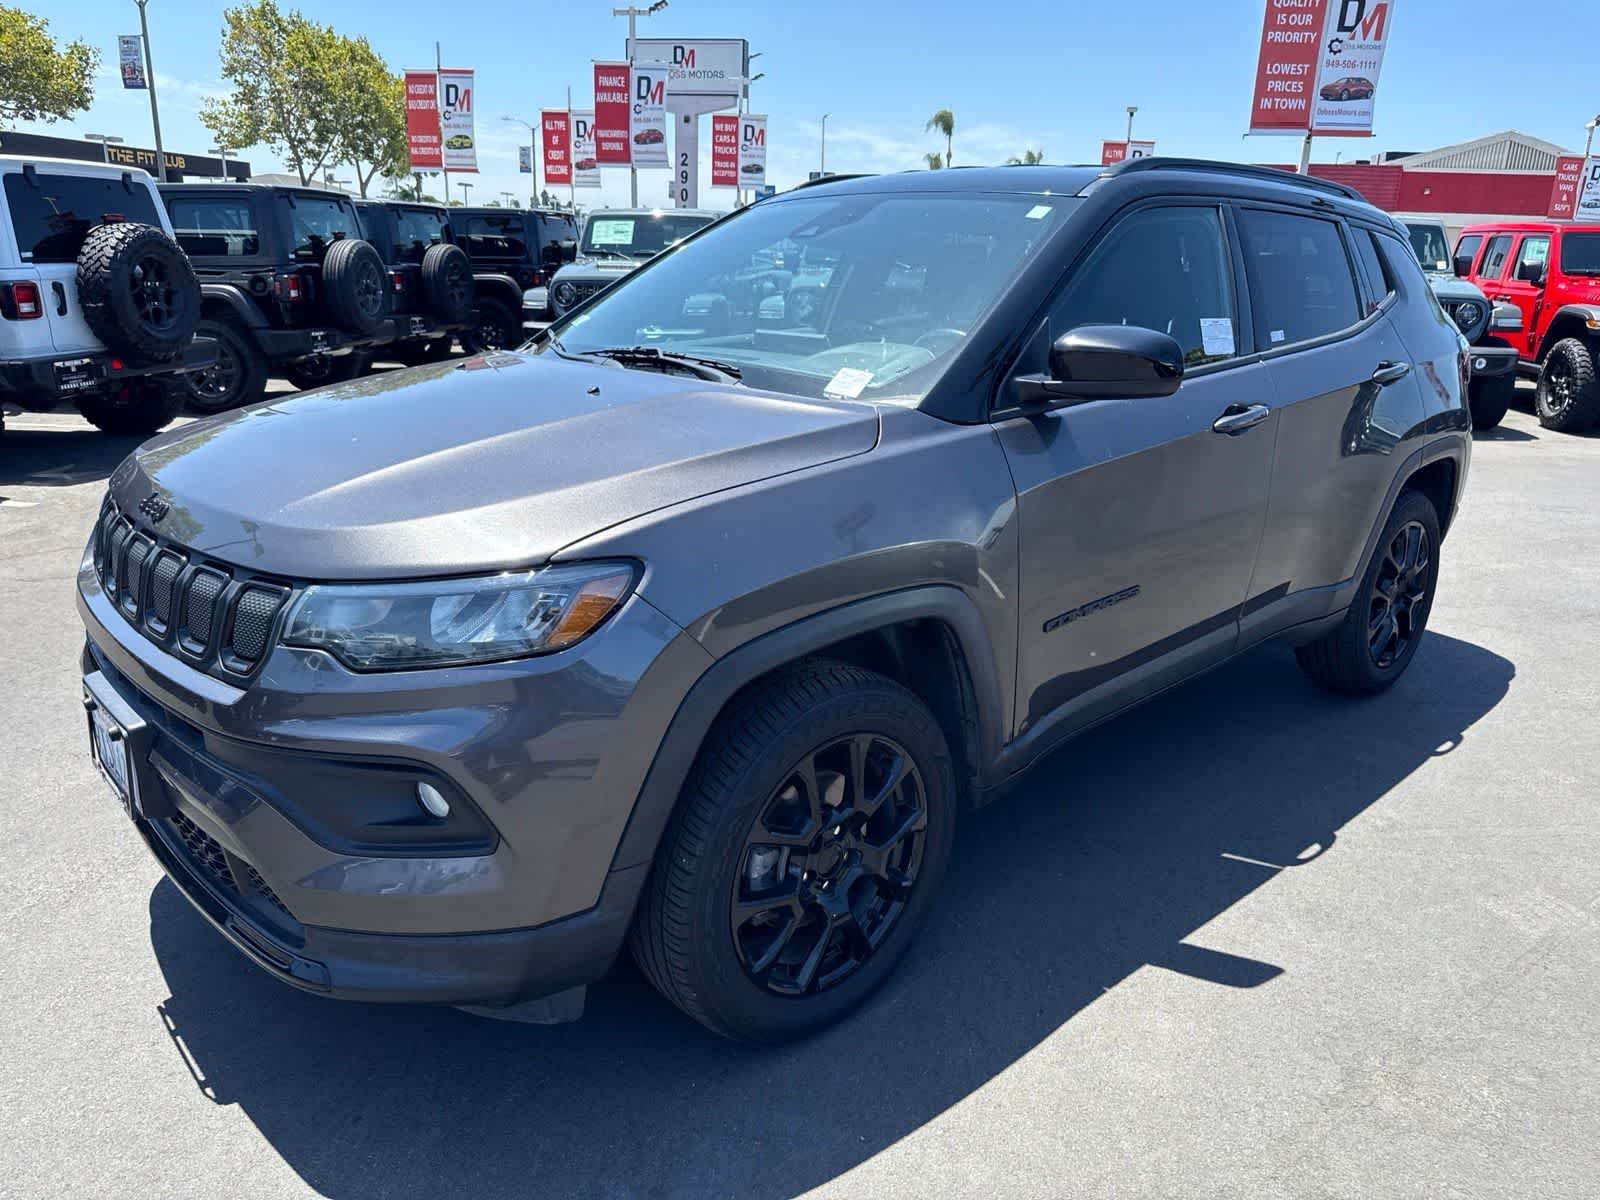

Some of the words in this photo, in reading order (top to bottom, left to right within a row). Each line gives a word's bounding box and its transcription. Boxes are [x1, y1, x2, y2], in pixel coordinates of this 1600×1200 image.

[1273, 0, 1320, 8] QUALITY
[1277, 13, 1287, 25] IS
[1289, 13, 1313, 26] OUR
[1267, 31, 1317, 44] PRIORITY
[688, 70, 725, 79] MOTORS
[1266, 63, 1310, 75] LOWEST
[599, 76, 625, 87] FINANCE
[1267, 80, 1304, 93] PRICES
[596, 92, 629, 104] AVAILABLE
[1260, 97, 1272, 110] IN
[1274, 97, 1306, 110] TOWN
[714, 146, 737, 155] TRUCKS
[108, 148, 135, 163] THE
[136, 151, 156, 165] FIT
[164, 154, 186, 168] LUB
